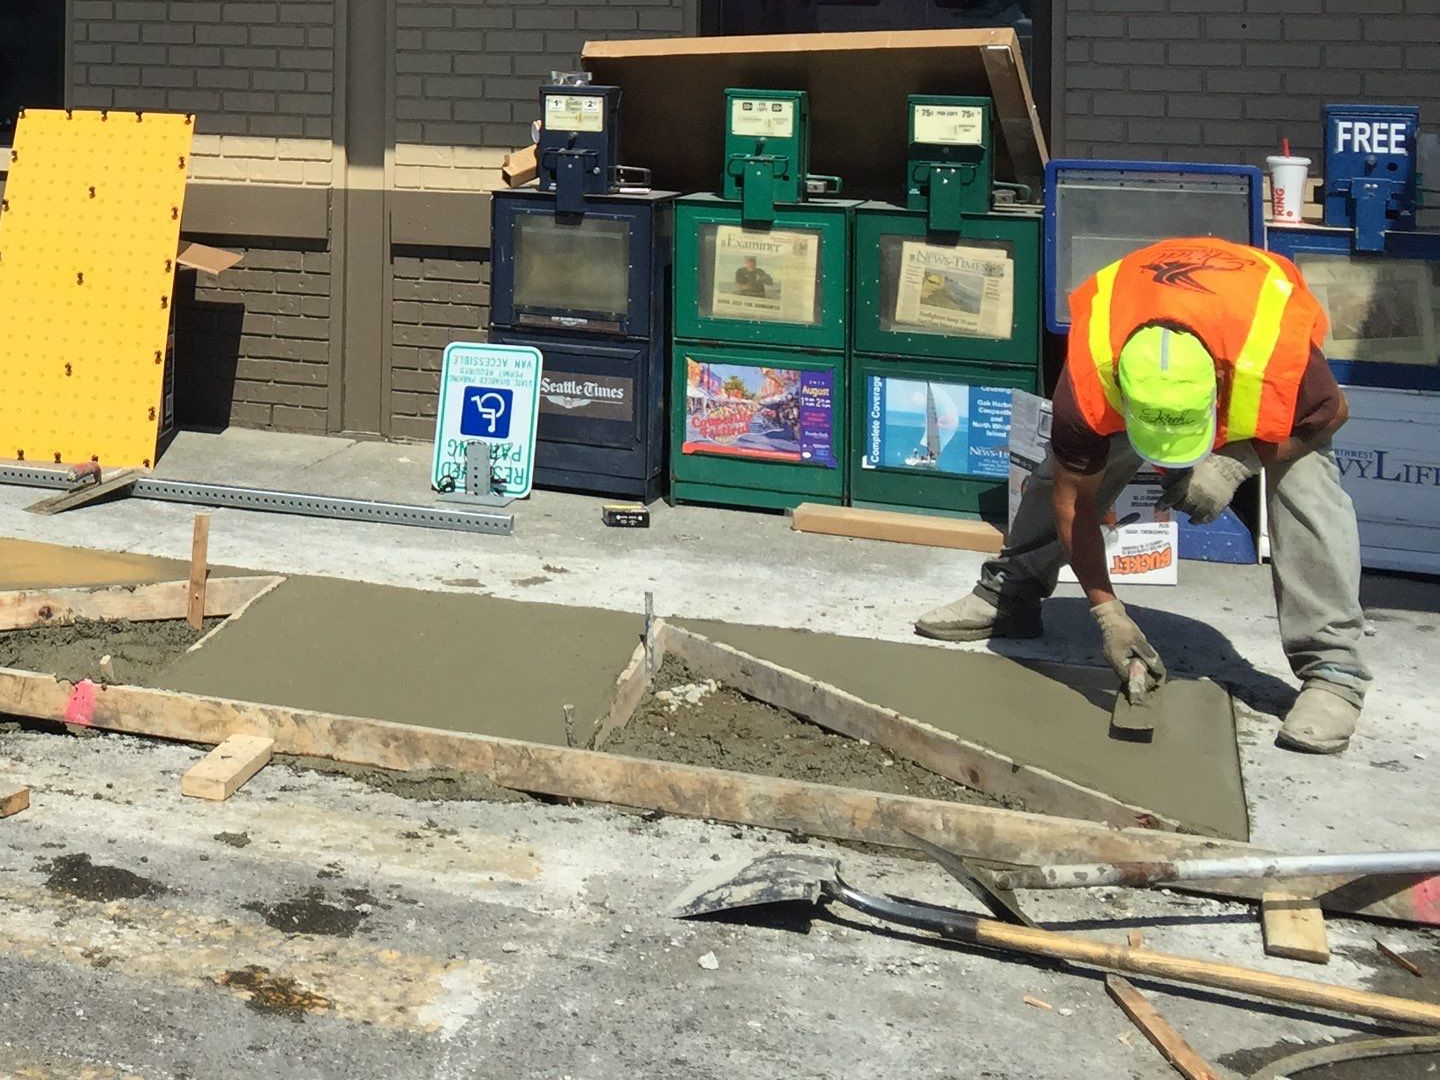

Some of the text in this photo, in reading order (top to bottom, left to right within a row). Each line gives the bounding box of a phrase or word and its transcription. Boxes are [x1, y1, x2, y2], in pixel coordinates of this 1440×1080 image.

[1337, 121, 1407, 155] FREE
[1276, 188, 1285, 216] KING
[727, 233, 782, 253] Examiner
[453, 355, 532, 369] VAN ACCESSIBLE
[449, 374, 533, 386] STATE DISABLED PARKING
[459, 367, 523, 379] PERMIT REQUIRED
[541, 377, 624, 399] Seattle Times
[802, 385, 830, 397] August
[870, 376, 881, 463] Complete Coverage
[972, 421, 990, 429] North
[986, 430, 1006, 438] Island
[446, 438, 522, 461] PARNG
[441, 461, 524, 485] RESED
[1109, 545, 1172, 575] BUCKET
